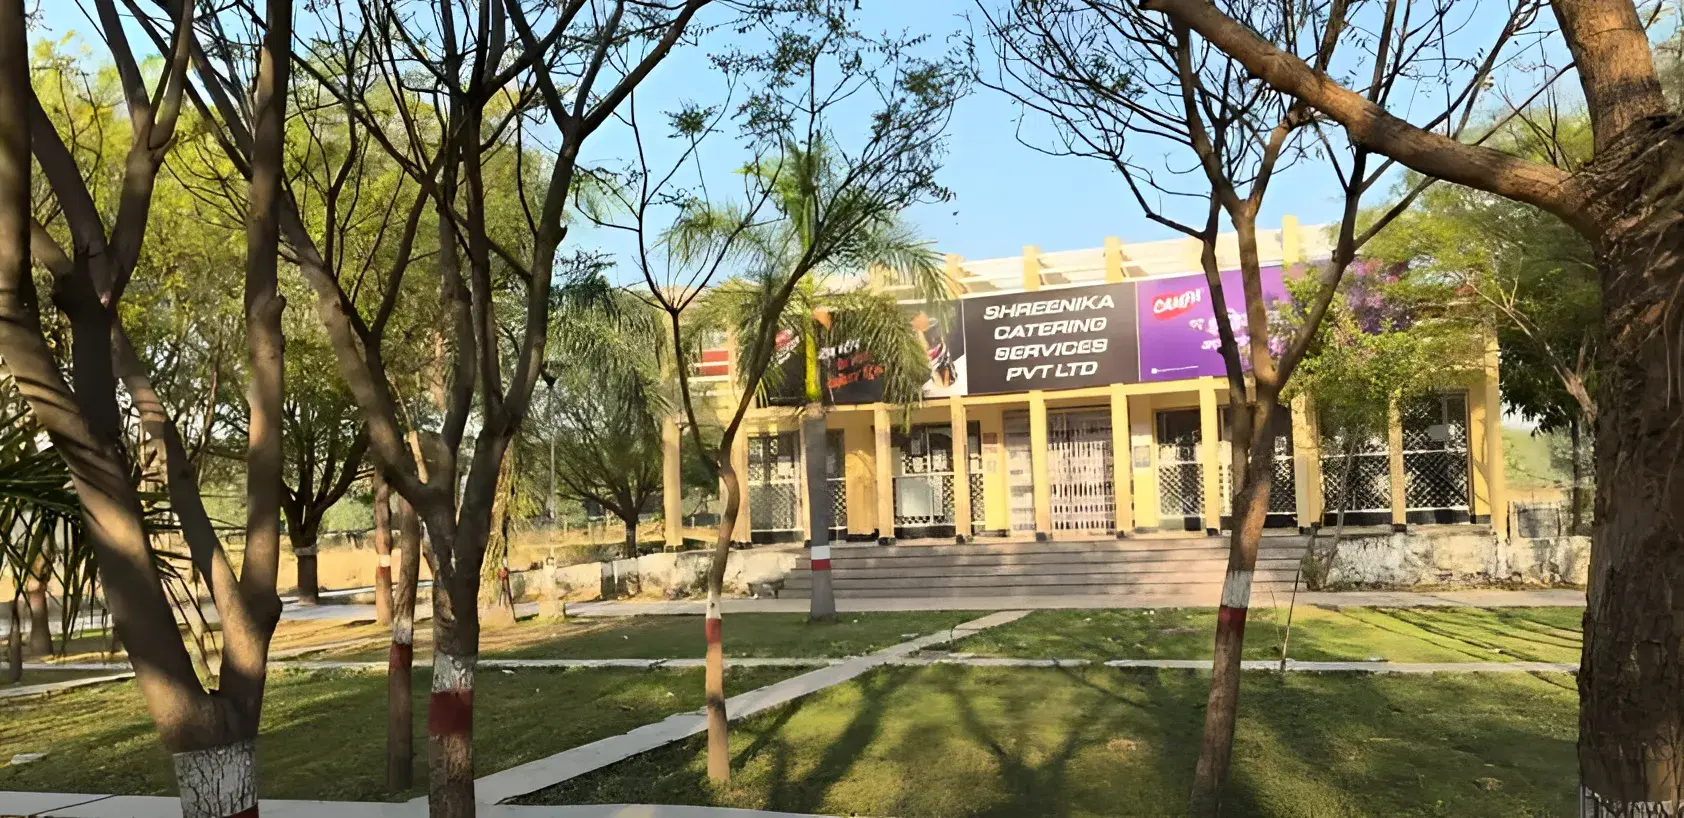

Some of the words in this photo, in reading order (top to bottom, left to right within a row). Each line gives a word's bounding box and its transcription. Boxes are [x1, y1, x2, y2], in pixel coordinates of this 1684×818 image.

[983, 295, 1115, 320] SHREENIKA
[994, 338, 1108, 361] SERVICES
[1006, 364, 1054, 382] PVT
[1055, 361, 1098, 378] LTD
